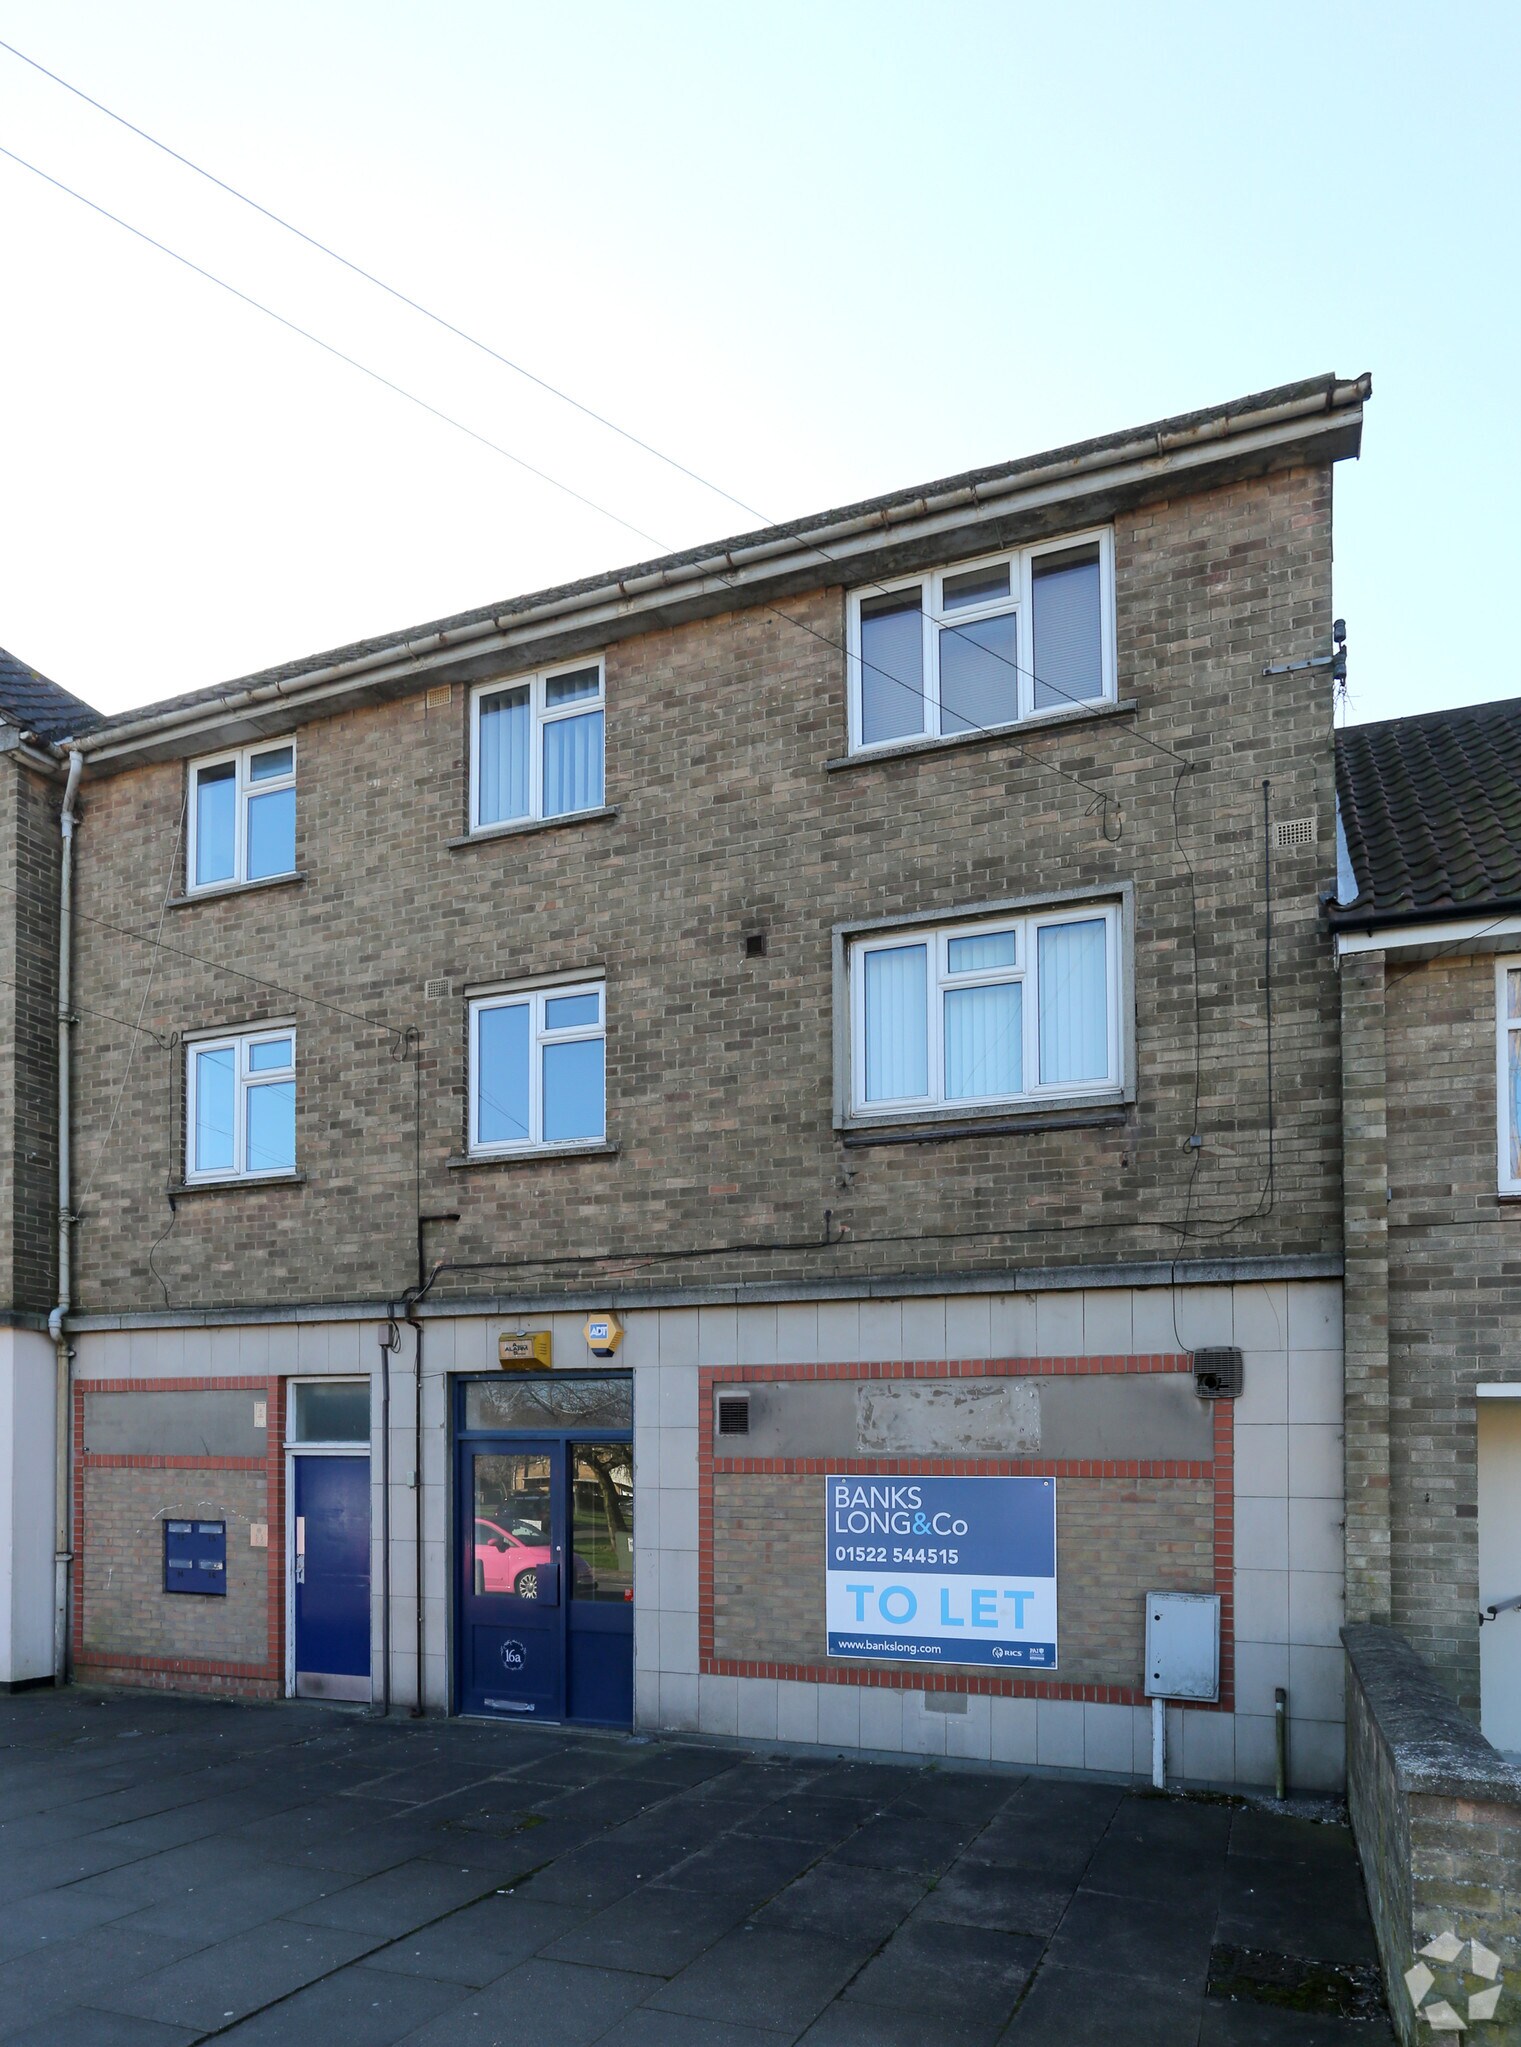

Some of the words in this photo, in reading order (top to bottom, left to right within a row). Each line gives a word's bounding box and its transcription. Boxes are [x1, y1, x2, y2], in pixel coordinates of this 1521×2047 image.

[591, 1326, 607, 1336] ADT
[835, 1486, 922, 1509] BANKS
[835, 1511, 968, 1535] LONG&Co
[835, 1546, 887, 1562] 01522
[893, 1548, 959, 1564] 544515
[846, 1585, 918, 1624] TO
[940, 1588, 1035, 1629] LET
[505, 1649, 521, 1662] 16a
[838, 1640, 941, 1655] www.bankslong.com
